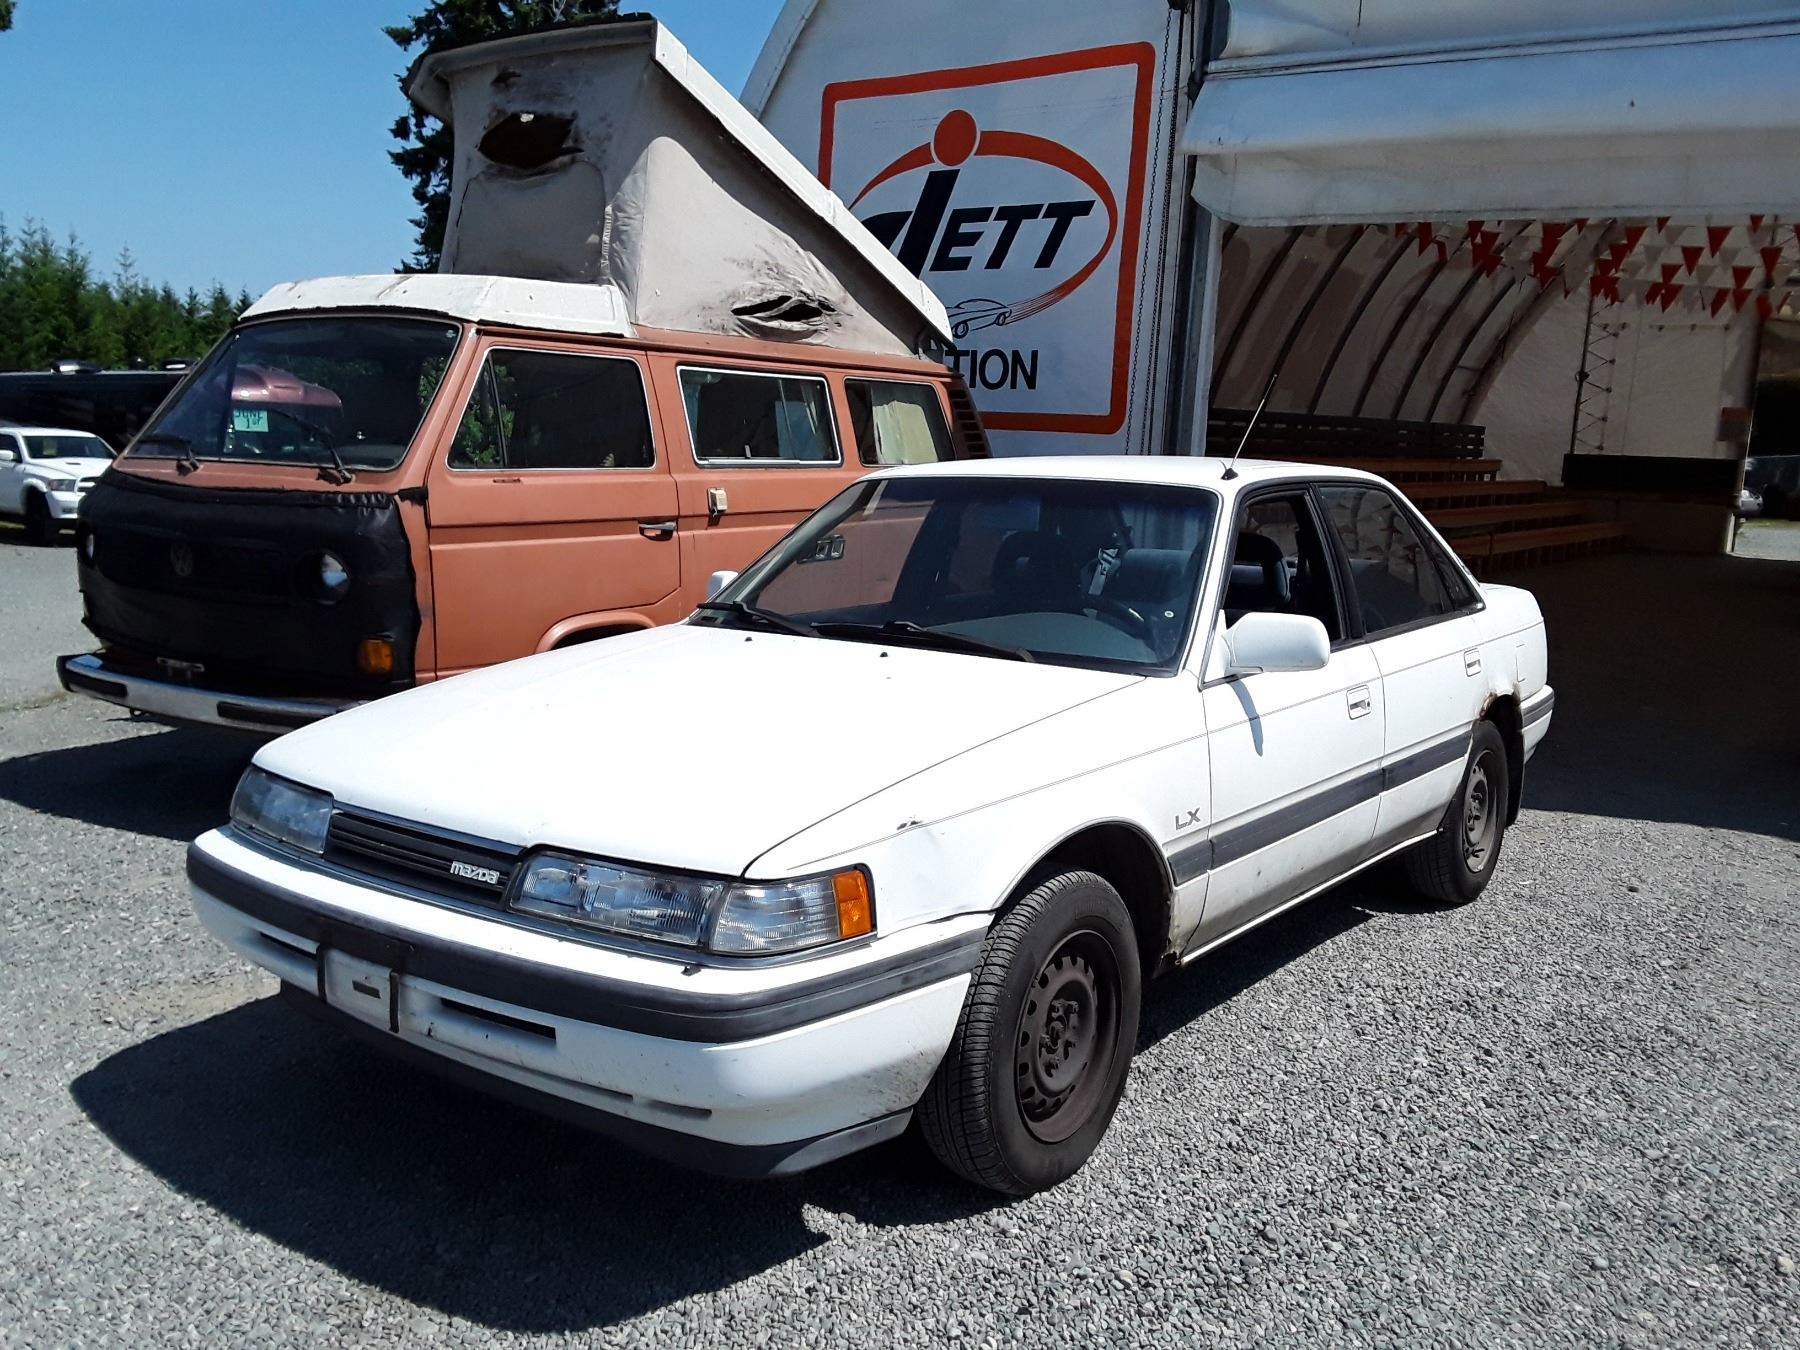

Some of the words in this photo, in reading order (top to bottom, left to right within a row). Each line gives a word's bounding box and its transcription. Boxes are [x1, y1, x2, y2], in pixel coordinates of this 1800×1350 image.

[945, 348, 1039, 390] TION
[1175, 807, 1201, 830] LX
[450, 860, 500, 884] mazda
